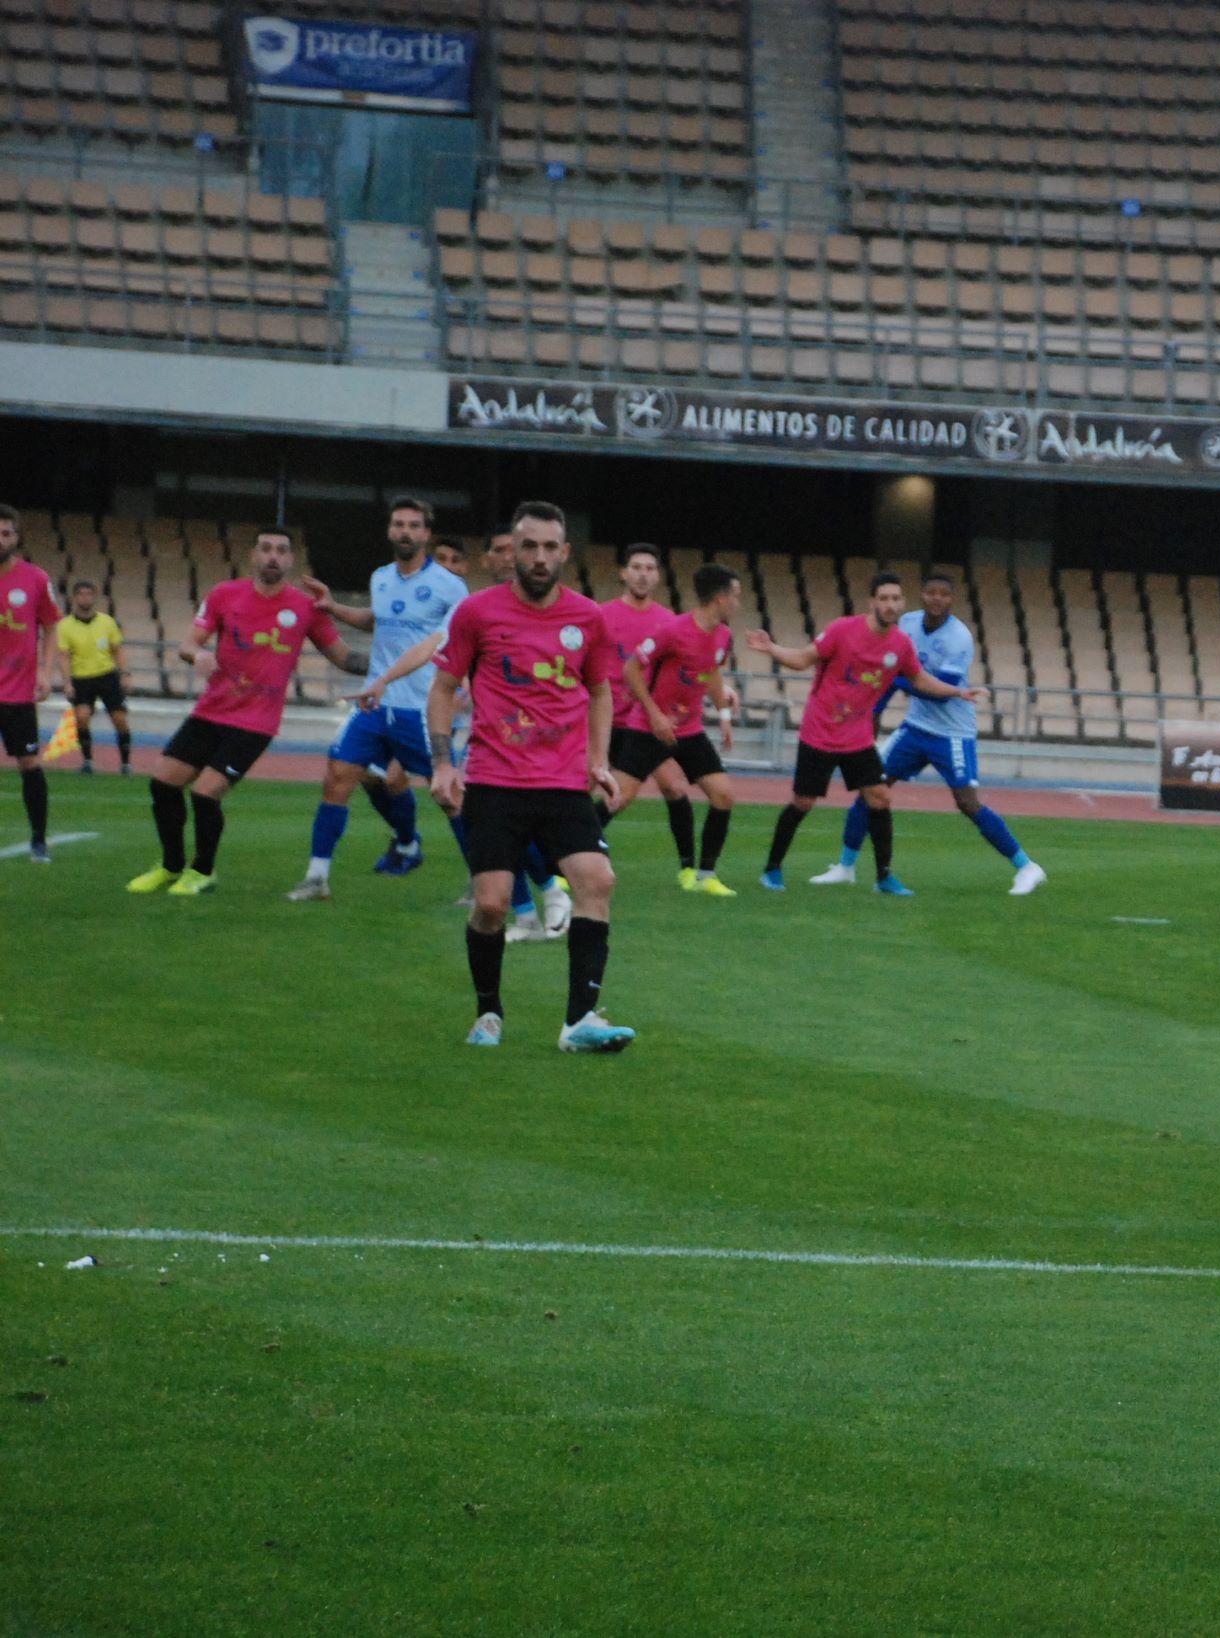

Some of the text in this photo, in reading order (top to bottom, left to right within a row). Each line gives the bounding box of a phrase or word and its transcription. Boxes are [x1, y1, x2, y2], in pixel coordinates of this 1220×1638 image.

[305, 28, 466, 64] prefortia
[682, 404, 967, 448] ALIMENTOS DE CALIDAD
